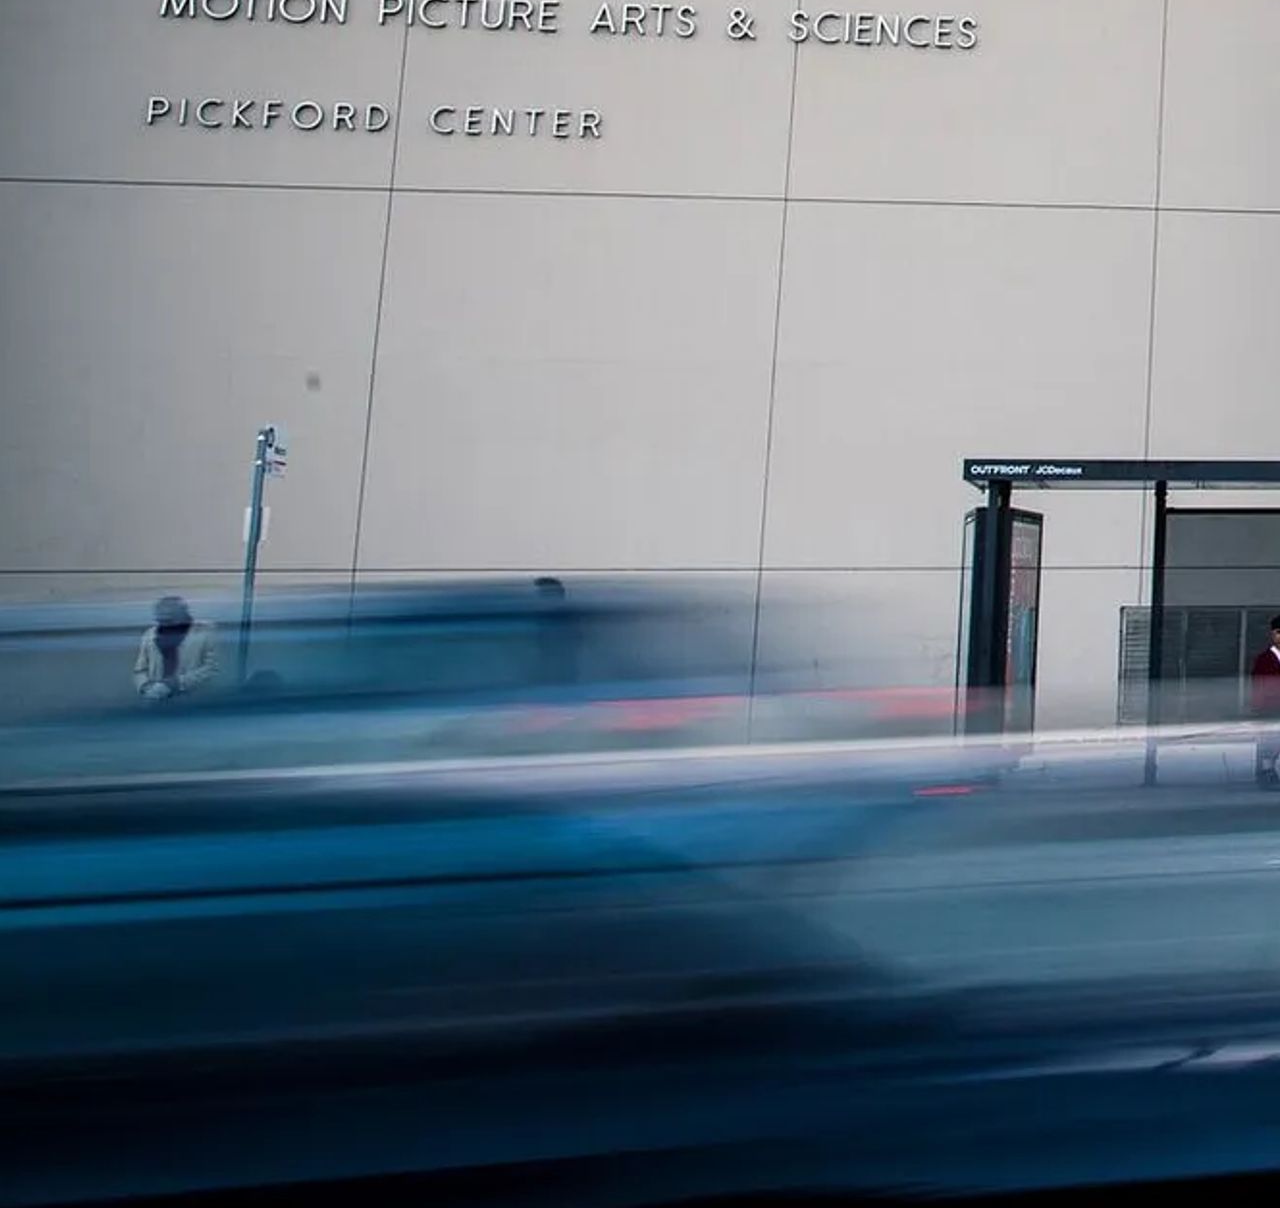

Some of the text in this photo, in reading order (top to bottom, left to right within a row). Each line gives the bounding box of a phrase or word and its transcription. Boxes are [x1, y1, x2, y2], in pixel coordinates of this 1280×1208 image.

[589, 2, 697, 39] ARTS
[726, 8, 756, 41] &
[787, 10, 980, 50] SCIENCES
[146, 96, 604, 140] PICKFORD CENTER
